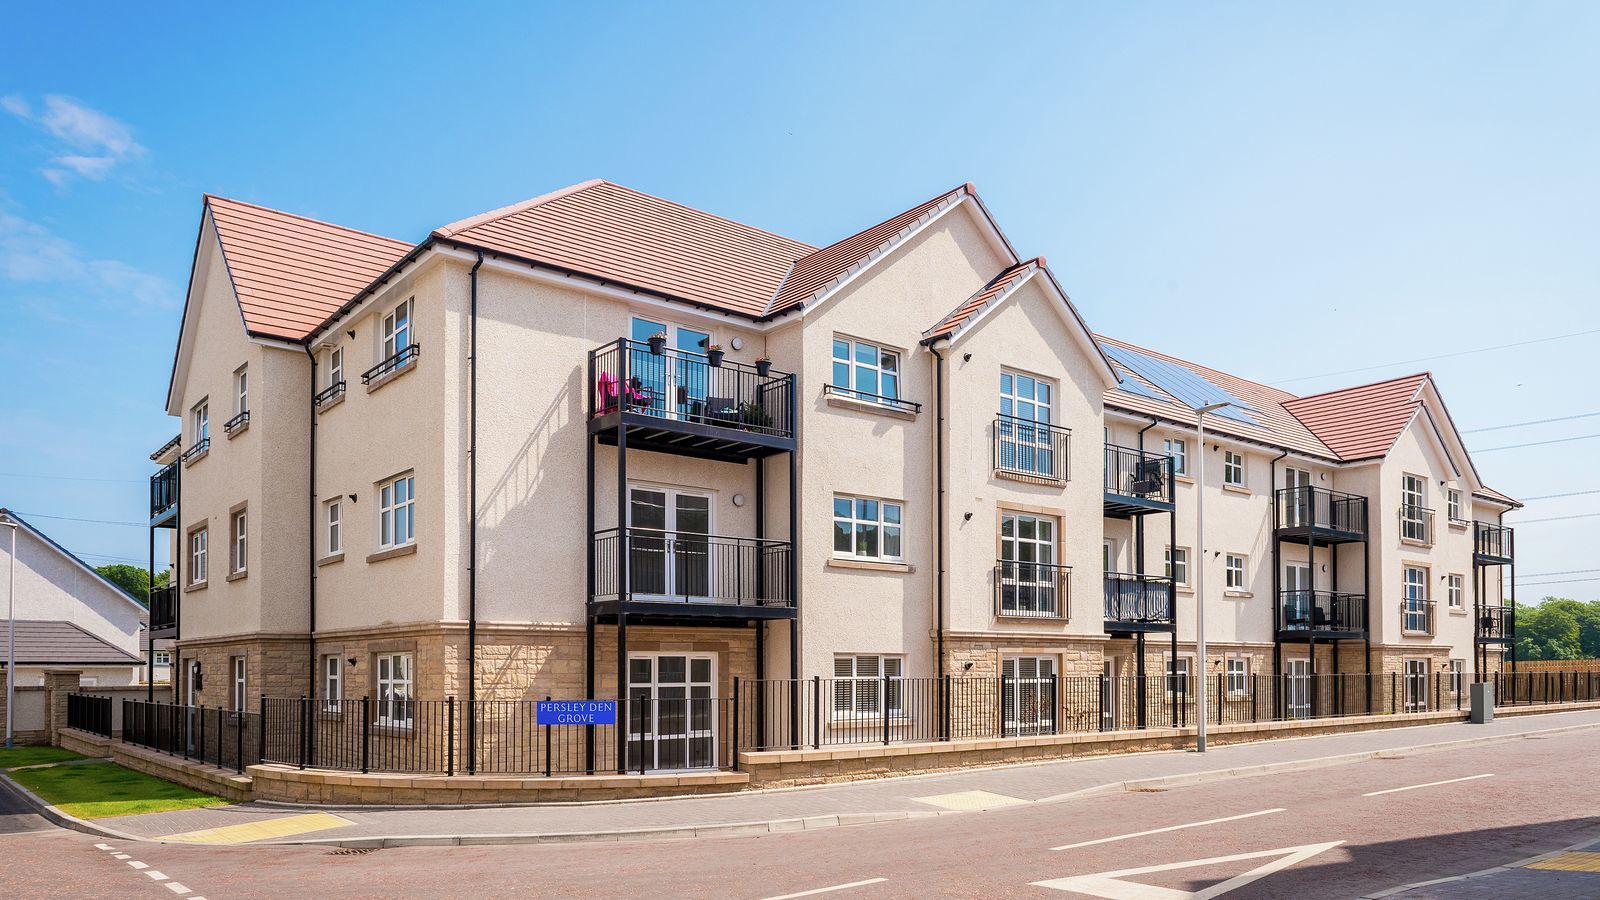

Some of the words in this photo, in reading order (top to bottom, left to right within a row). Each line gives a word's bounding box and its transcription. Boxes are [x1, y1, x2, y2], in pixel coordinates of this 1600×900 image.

[540, 703, 586, 712] PERSLEY
[589, 703, 612, 712] DEN
[557, 714, 595, 723] GROVE
